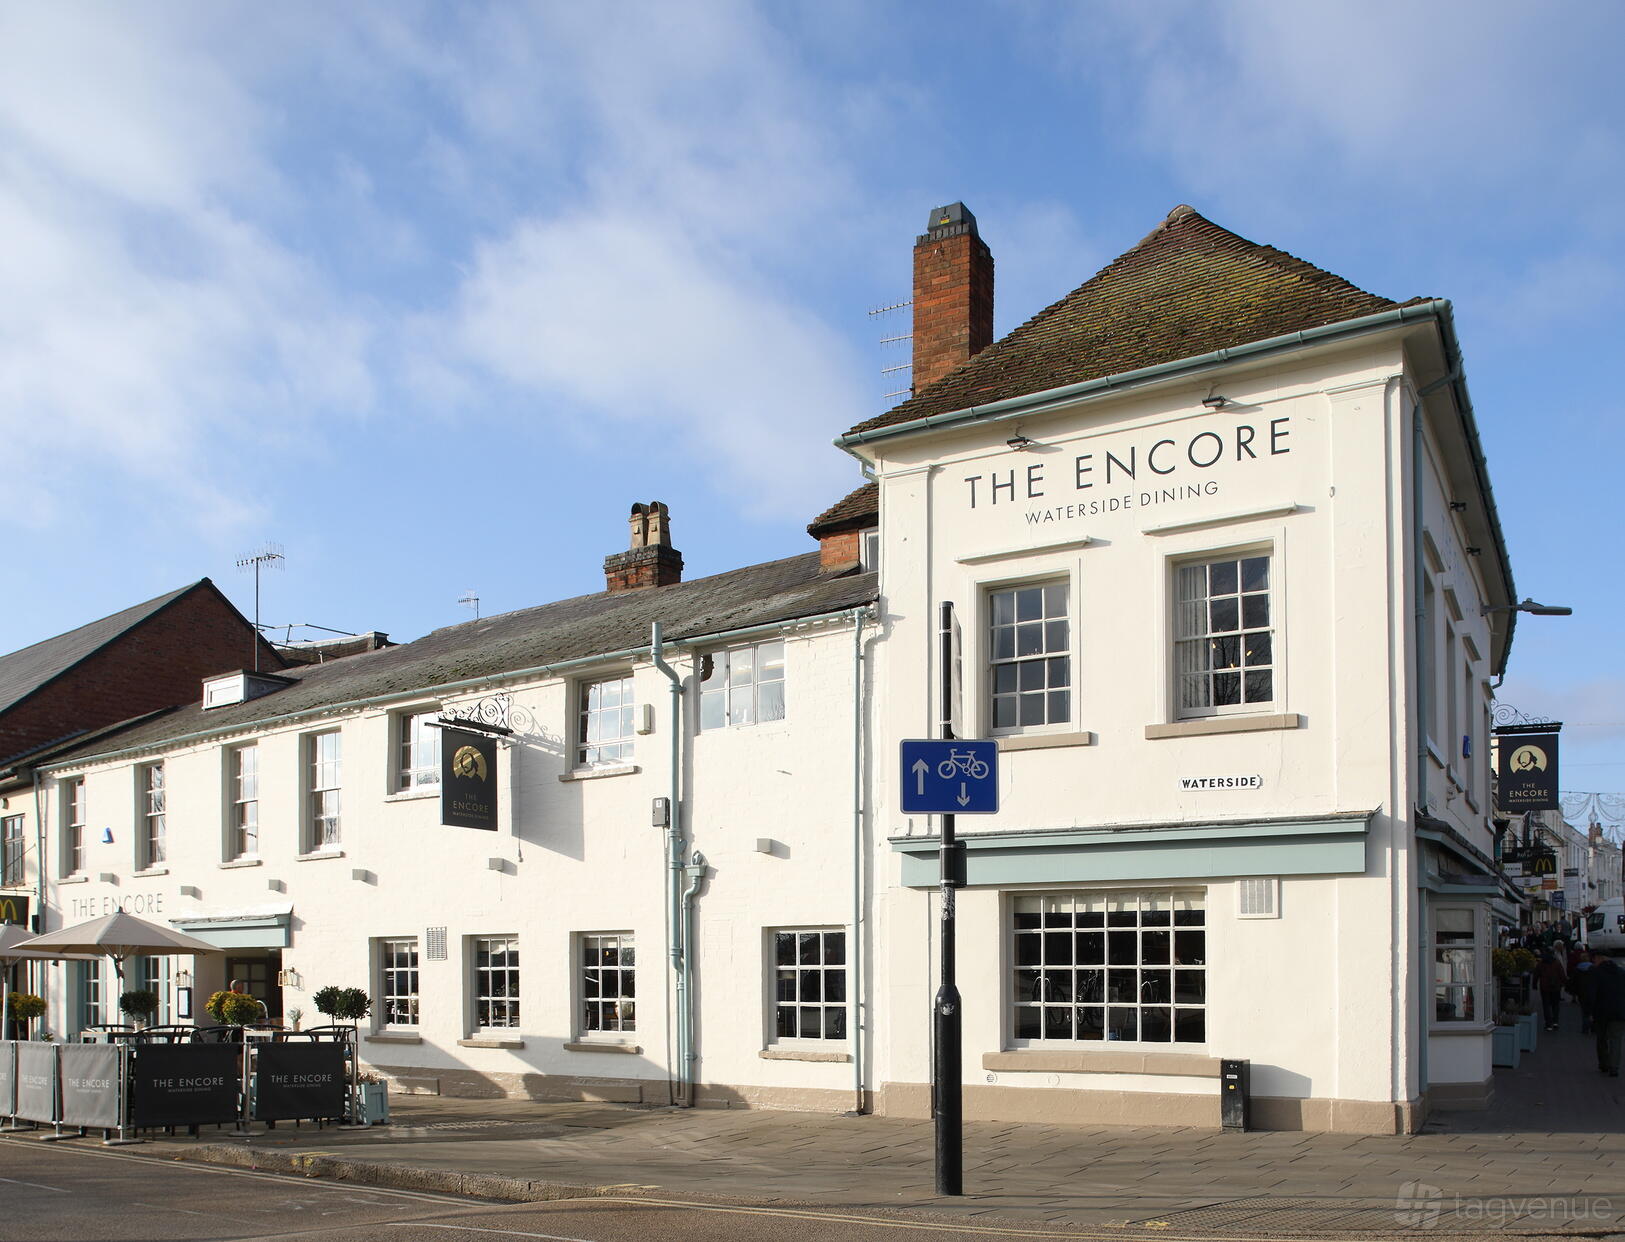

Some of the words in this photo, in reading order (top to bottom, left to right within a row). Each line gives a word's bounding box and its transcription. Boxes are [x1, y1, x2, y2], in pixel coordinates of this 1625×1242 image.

[964, 463, 1045, 509] THE
[1075, 417, 1291, 490] ENCORE
[1025, 496, 1133, 525] WATERSIDE
[1139, 480, 1219, 507] DINING
[1182, 776, 1257, 789] WATERSIDE
[1509, 789, 1549, 798] ENCORE
[453, 800, 489, 812] ENCORE
[72, 897, 95, 918] THE
[103, 893, 163, 916] ENCORE
[68, 1078, 79, 1088] THE
[82, 1079, 110, 1089] ENCORE
[152, 1079, 173, 1088] THE
[179, 1077, 224, 1087] ENCORE
[271, 1074, 289, 1083] THE
[293, 1073, 333, 1083] ENCORE
